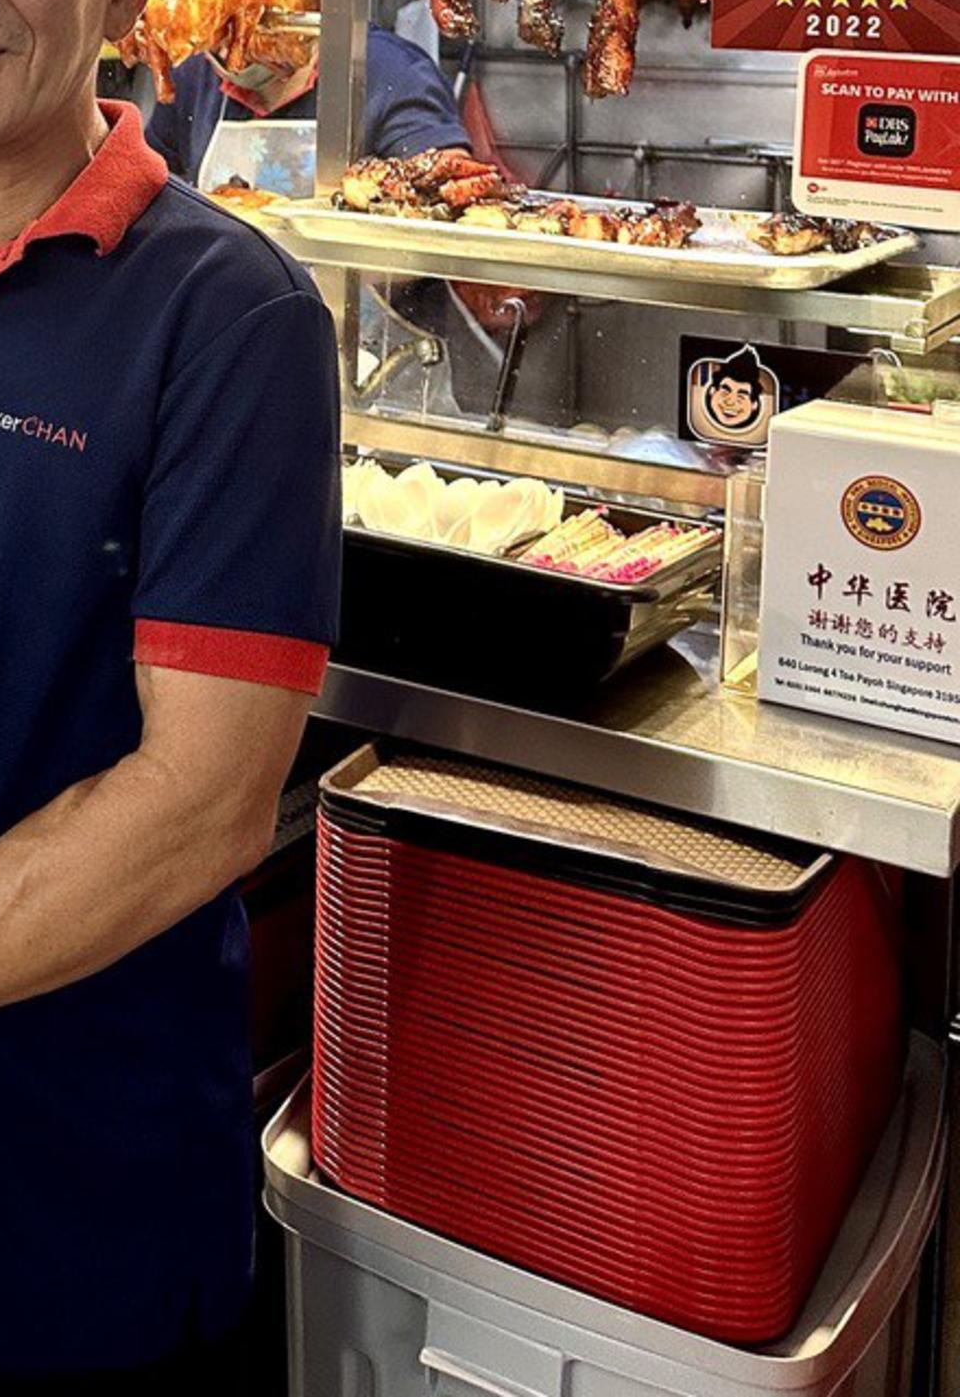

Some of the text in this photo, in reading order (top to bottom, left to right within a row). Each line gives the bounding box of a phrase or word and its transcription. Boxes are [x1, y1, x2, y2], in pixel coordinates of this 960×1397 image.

[806, 15, 881, 38] 2022
[821, 83, 959, 103] SCAN TO PAY WITH
[879, 117, 910, 132] DBS
[807, 562, 956, 622] 中华医院
[808, 608, 946, 655] 谢谢您的支持
[800, 633, 952, 676] Thank you for your support
[778, 657, 797, 670] 640
[798, 661, 829, 678] Lorong
[831, 667, 838, 678] 4
[839, 669, 855, 682] Toa
[856, 673, 885, 689] Payoh
[885, 679, 934, 699] Singapore
